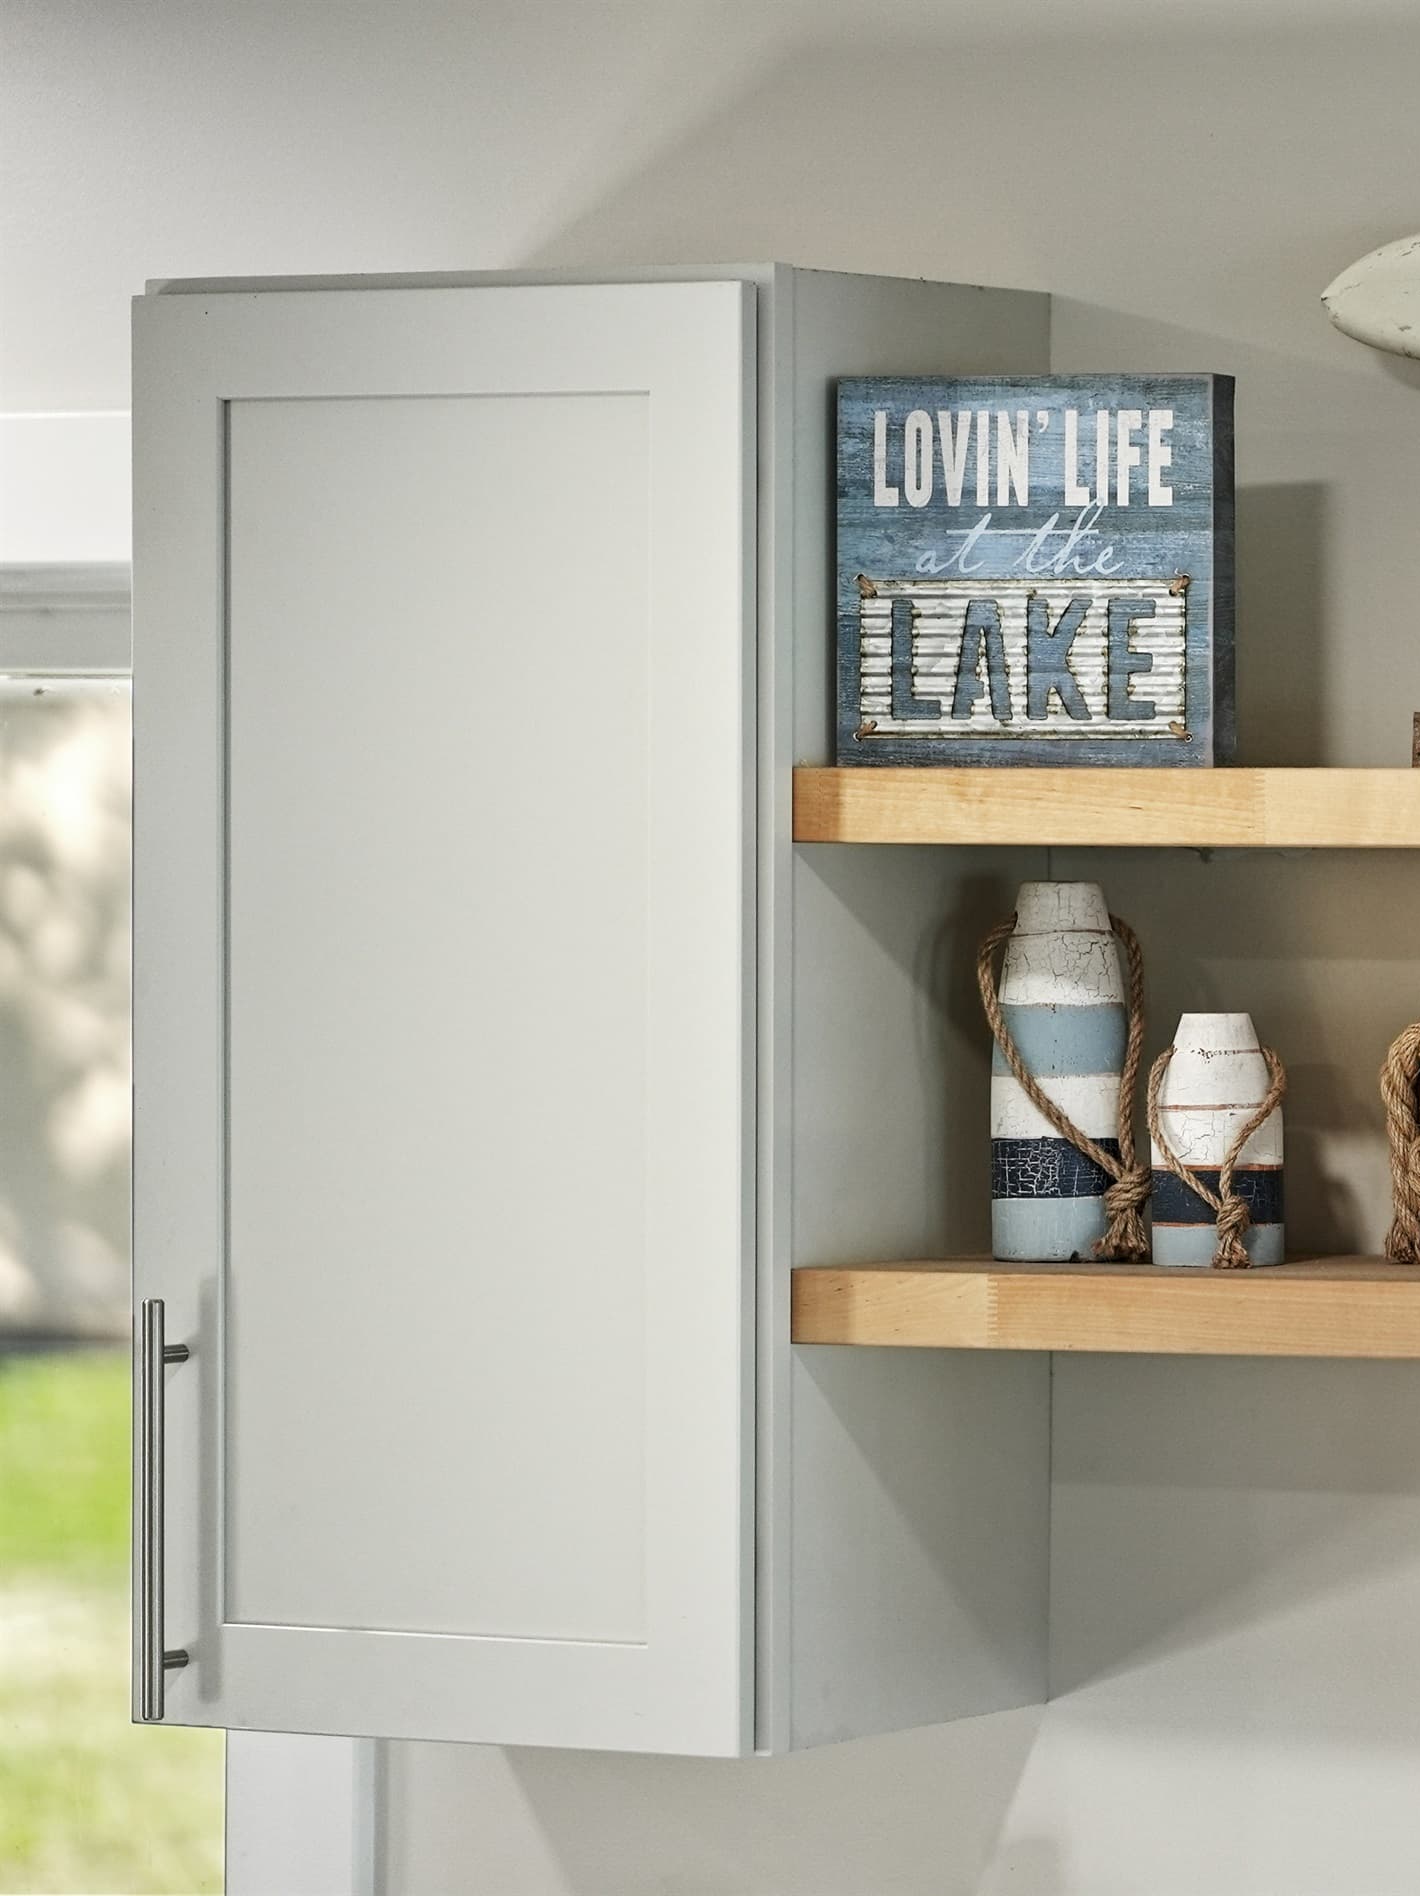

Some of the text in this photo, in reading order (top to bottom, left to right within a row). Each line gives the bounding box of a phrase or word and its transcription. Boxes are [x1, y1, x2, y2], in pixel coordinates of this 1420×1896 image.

[873, 409, 1174, 508] LOVIN' LIFE
[915, 498, 1124, 575] at the
[890, 599, 1156, 720] LAKE
